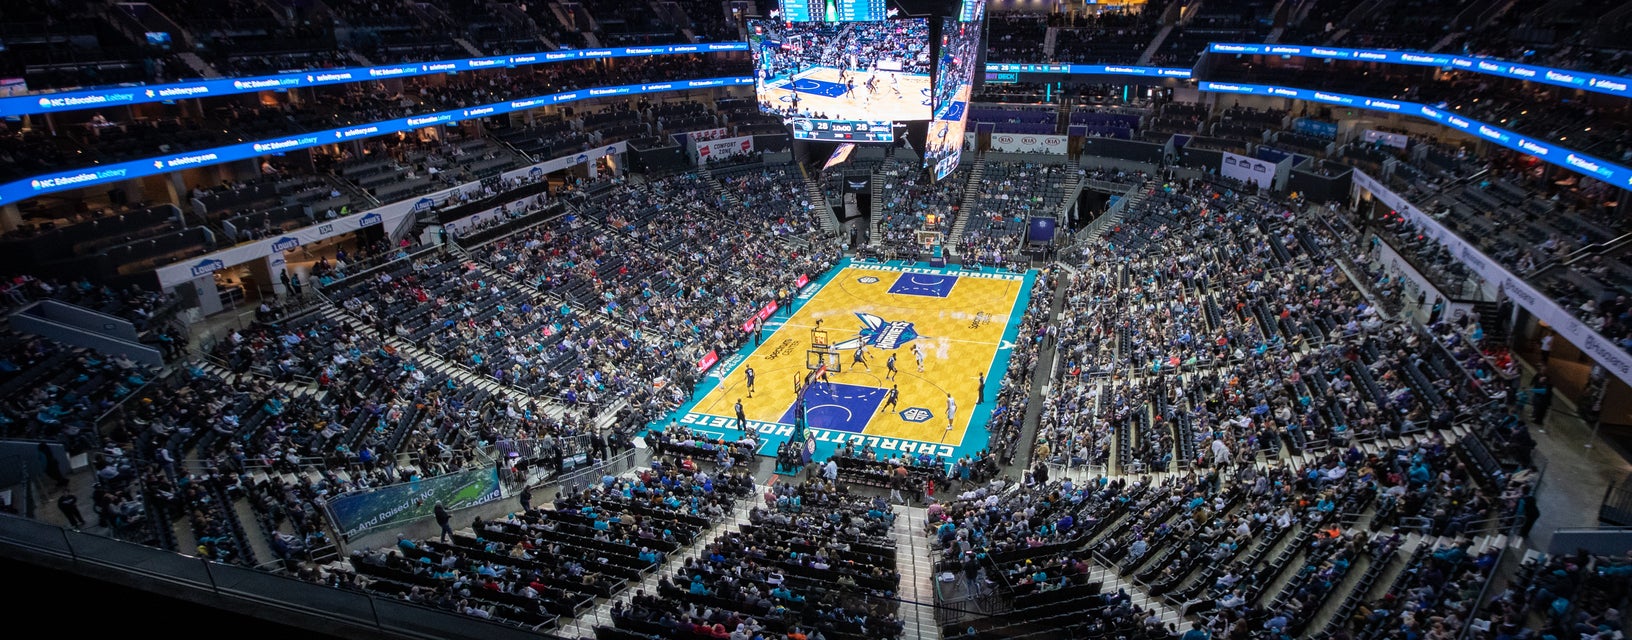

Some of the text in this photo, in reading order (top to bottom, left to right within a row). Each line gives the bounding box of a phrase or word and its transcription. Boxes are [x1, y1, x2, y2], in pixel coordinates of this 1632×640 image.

[65, 95, 106, 105] Education
[106, 93, 134, 102] Lottery
[41, 168, 127, 188] NC Education Lottery
[360, 216, 381, 226] LOWE'S
[273, 239, 298, 252] LOWE'S
[194, 262, 223, 276] LOWE'S
[849, 264, 1024, 281] CHARLOTTE HORNETS
[680, 414, 794, 436] HORNETS
[358, 517, 377, 533] And
[379, 501, 410, 519] Raised
[410, 497, 418, 506] In
[421, 488, 434, 498] NC
